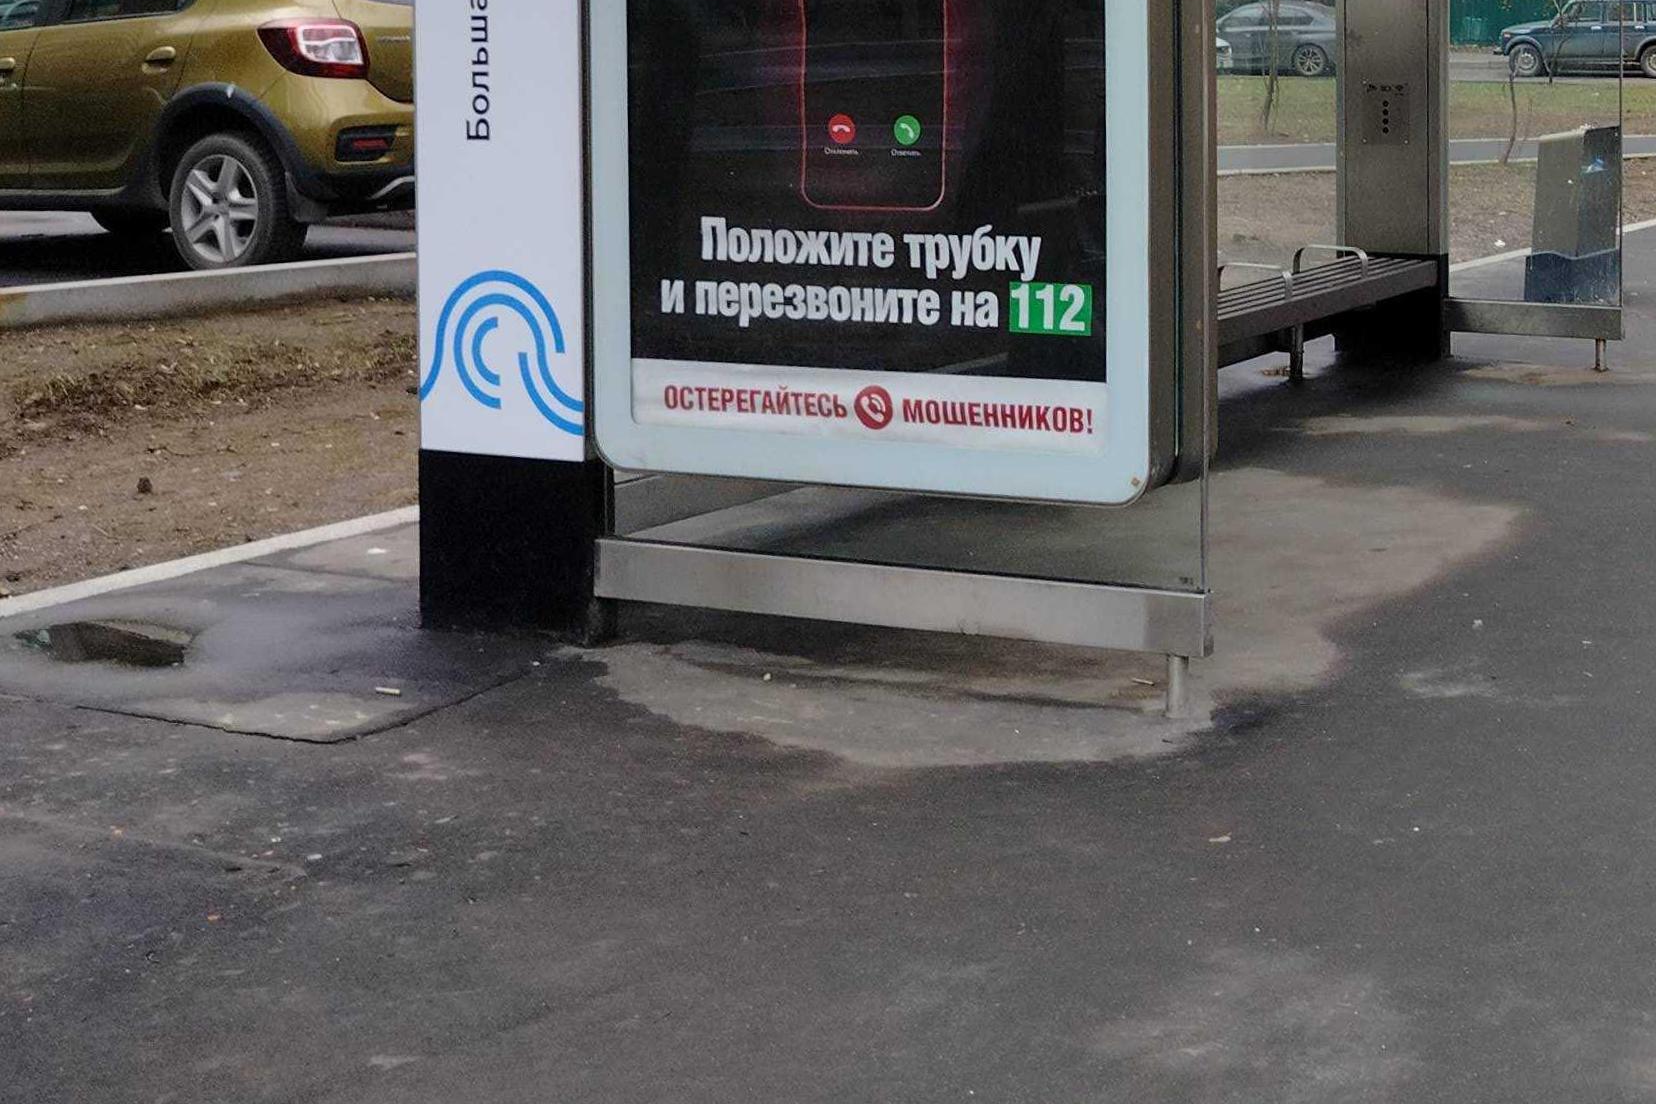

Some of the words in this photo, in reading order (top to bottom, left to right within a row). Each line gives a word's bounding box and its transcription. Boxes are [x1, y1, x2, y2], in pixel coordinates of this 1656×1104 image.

[700, 216, 895, 268] Положите
[903, 224, 1042, 282] трубку
[661, 278, 685, 314] и
[695, 279, 940, 327] перезвоните
[950, 290, 999, 328] на
[1010, 283, 1086, 332] 112
[663, 384, 848, 419] ОСТЕРЕГАЙТЕСЬ
[902, 397, 1093, 435] МОШЕННИКОВ!
